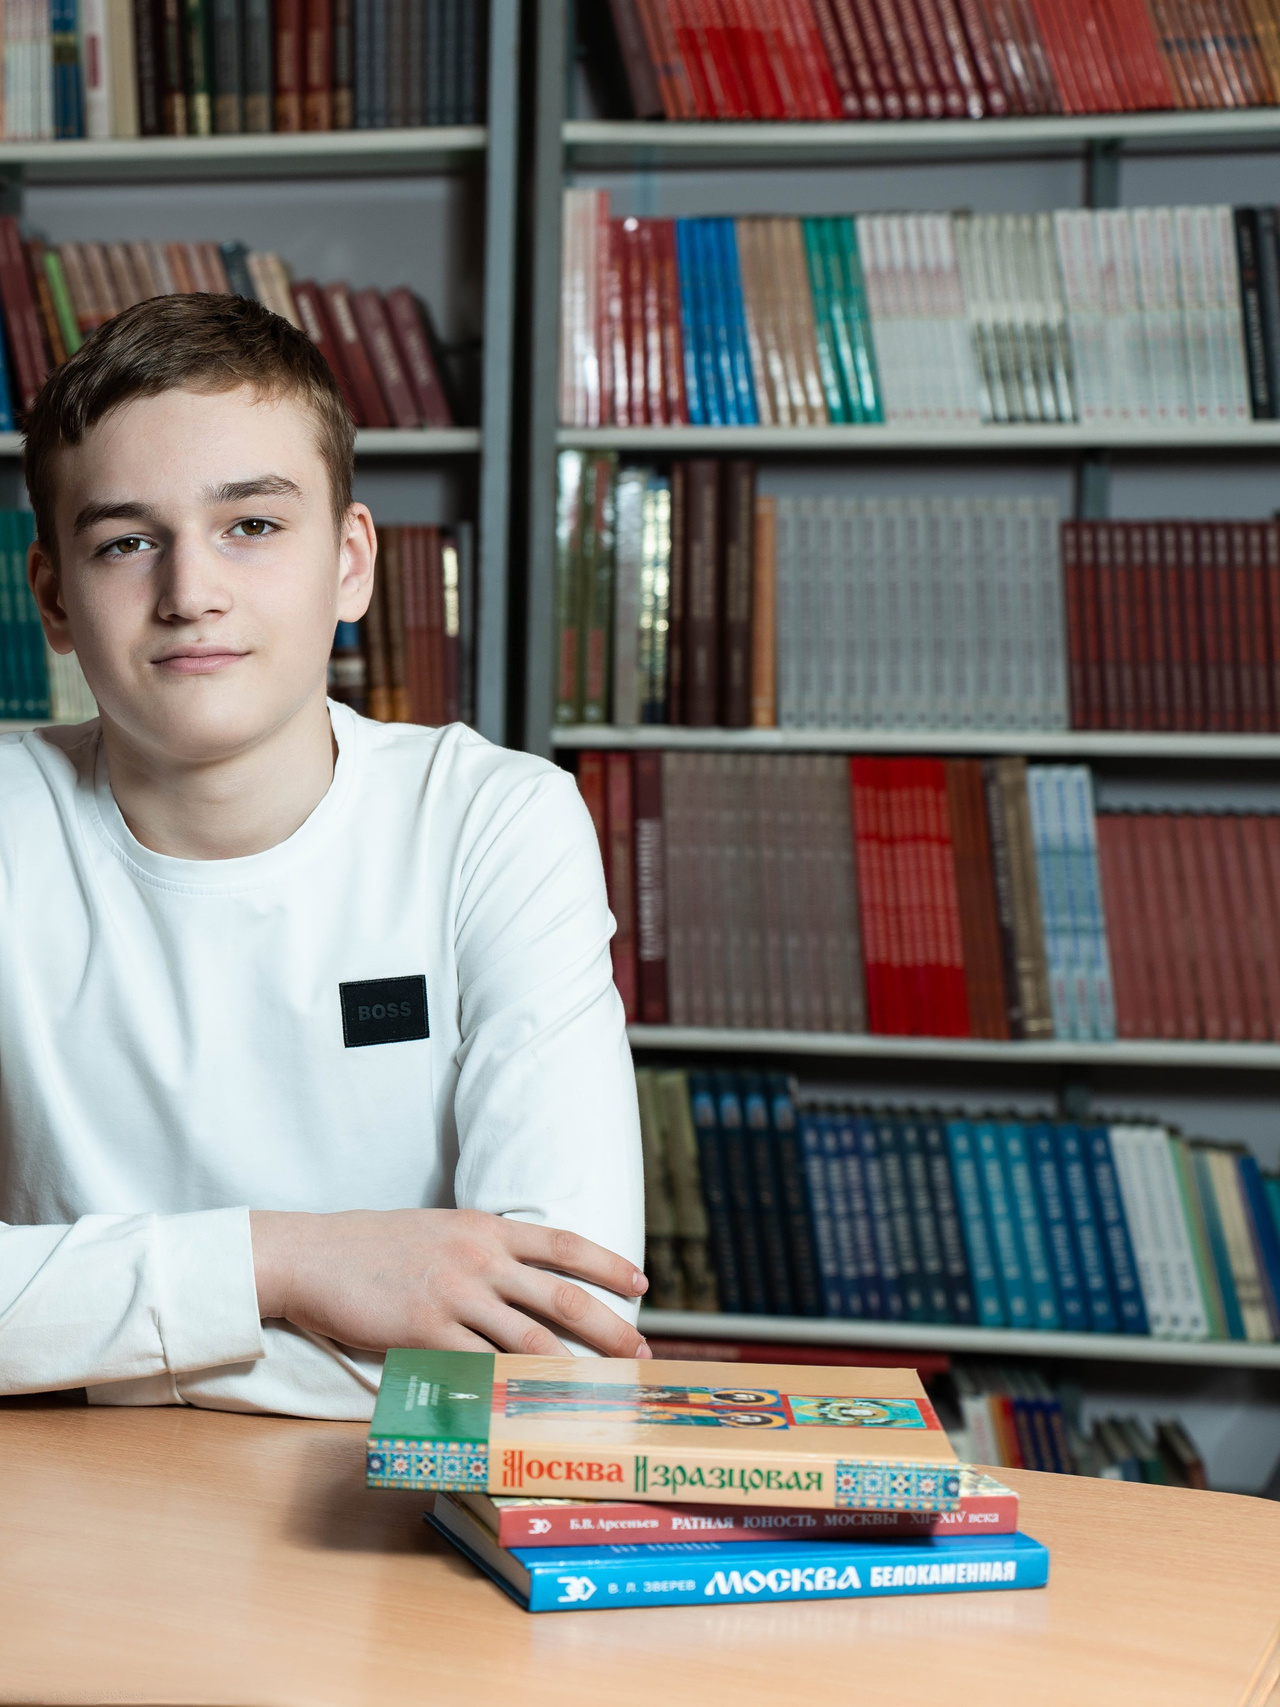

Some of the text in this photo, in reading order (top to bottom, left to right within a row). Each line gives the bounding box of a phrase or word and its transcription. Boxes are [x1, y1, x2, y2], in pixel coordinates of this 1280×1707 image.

[357, 1000, 412, 1021] BOSS
[502, 1449, 823, 1496] Москва Изразцовая
[597, 1517, 659, 1532] Арсеньев
[671, 1516, 735, 1530] РАТНАЯ
[743, 1514, 817, 1528] ЮНОСТЬ
[824, 1512, 899, 1527] МОСКВЫ
[968, 1512, 1000, 1524] века
[643, 1579, 696, 1593] ЗВЕРЕВ
[704, 1565, 862, 1596] МОСКВА
[870, 1560, 1017, 1588] БЕЛОКАМЕННАЯ
